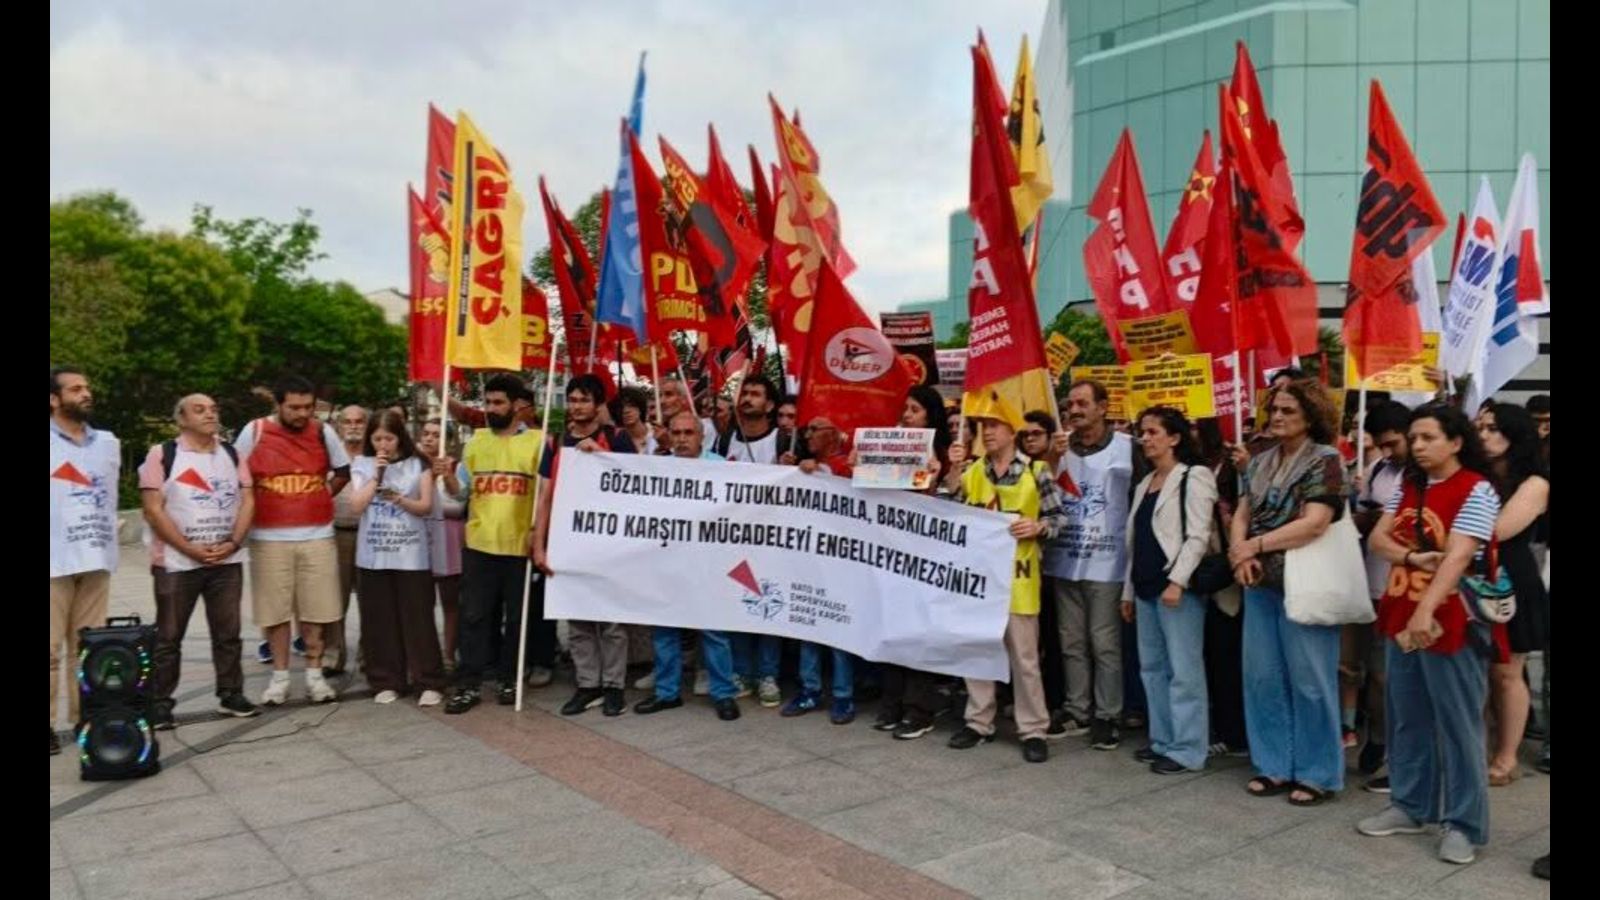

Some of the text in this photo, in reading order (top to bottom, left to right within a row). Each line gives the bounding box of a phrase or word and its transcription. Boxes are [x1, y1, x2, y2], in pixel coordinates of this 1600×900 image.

[600, 469, 968, 547] GÖZALTILARLA, TUTUKLAMALARLA, BASKILARLA
[572, 510, 988, 599] NATO KARŞITI MÜCADELEYİ ENGELLEYEMEZSİNİZ!
